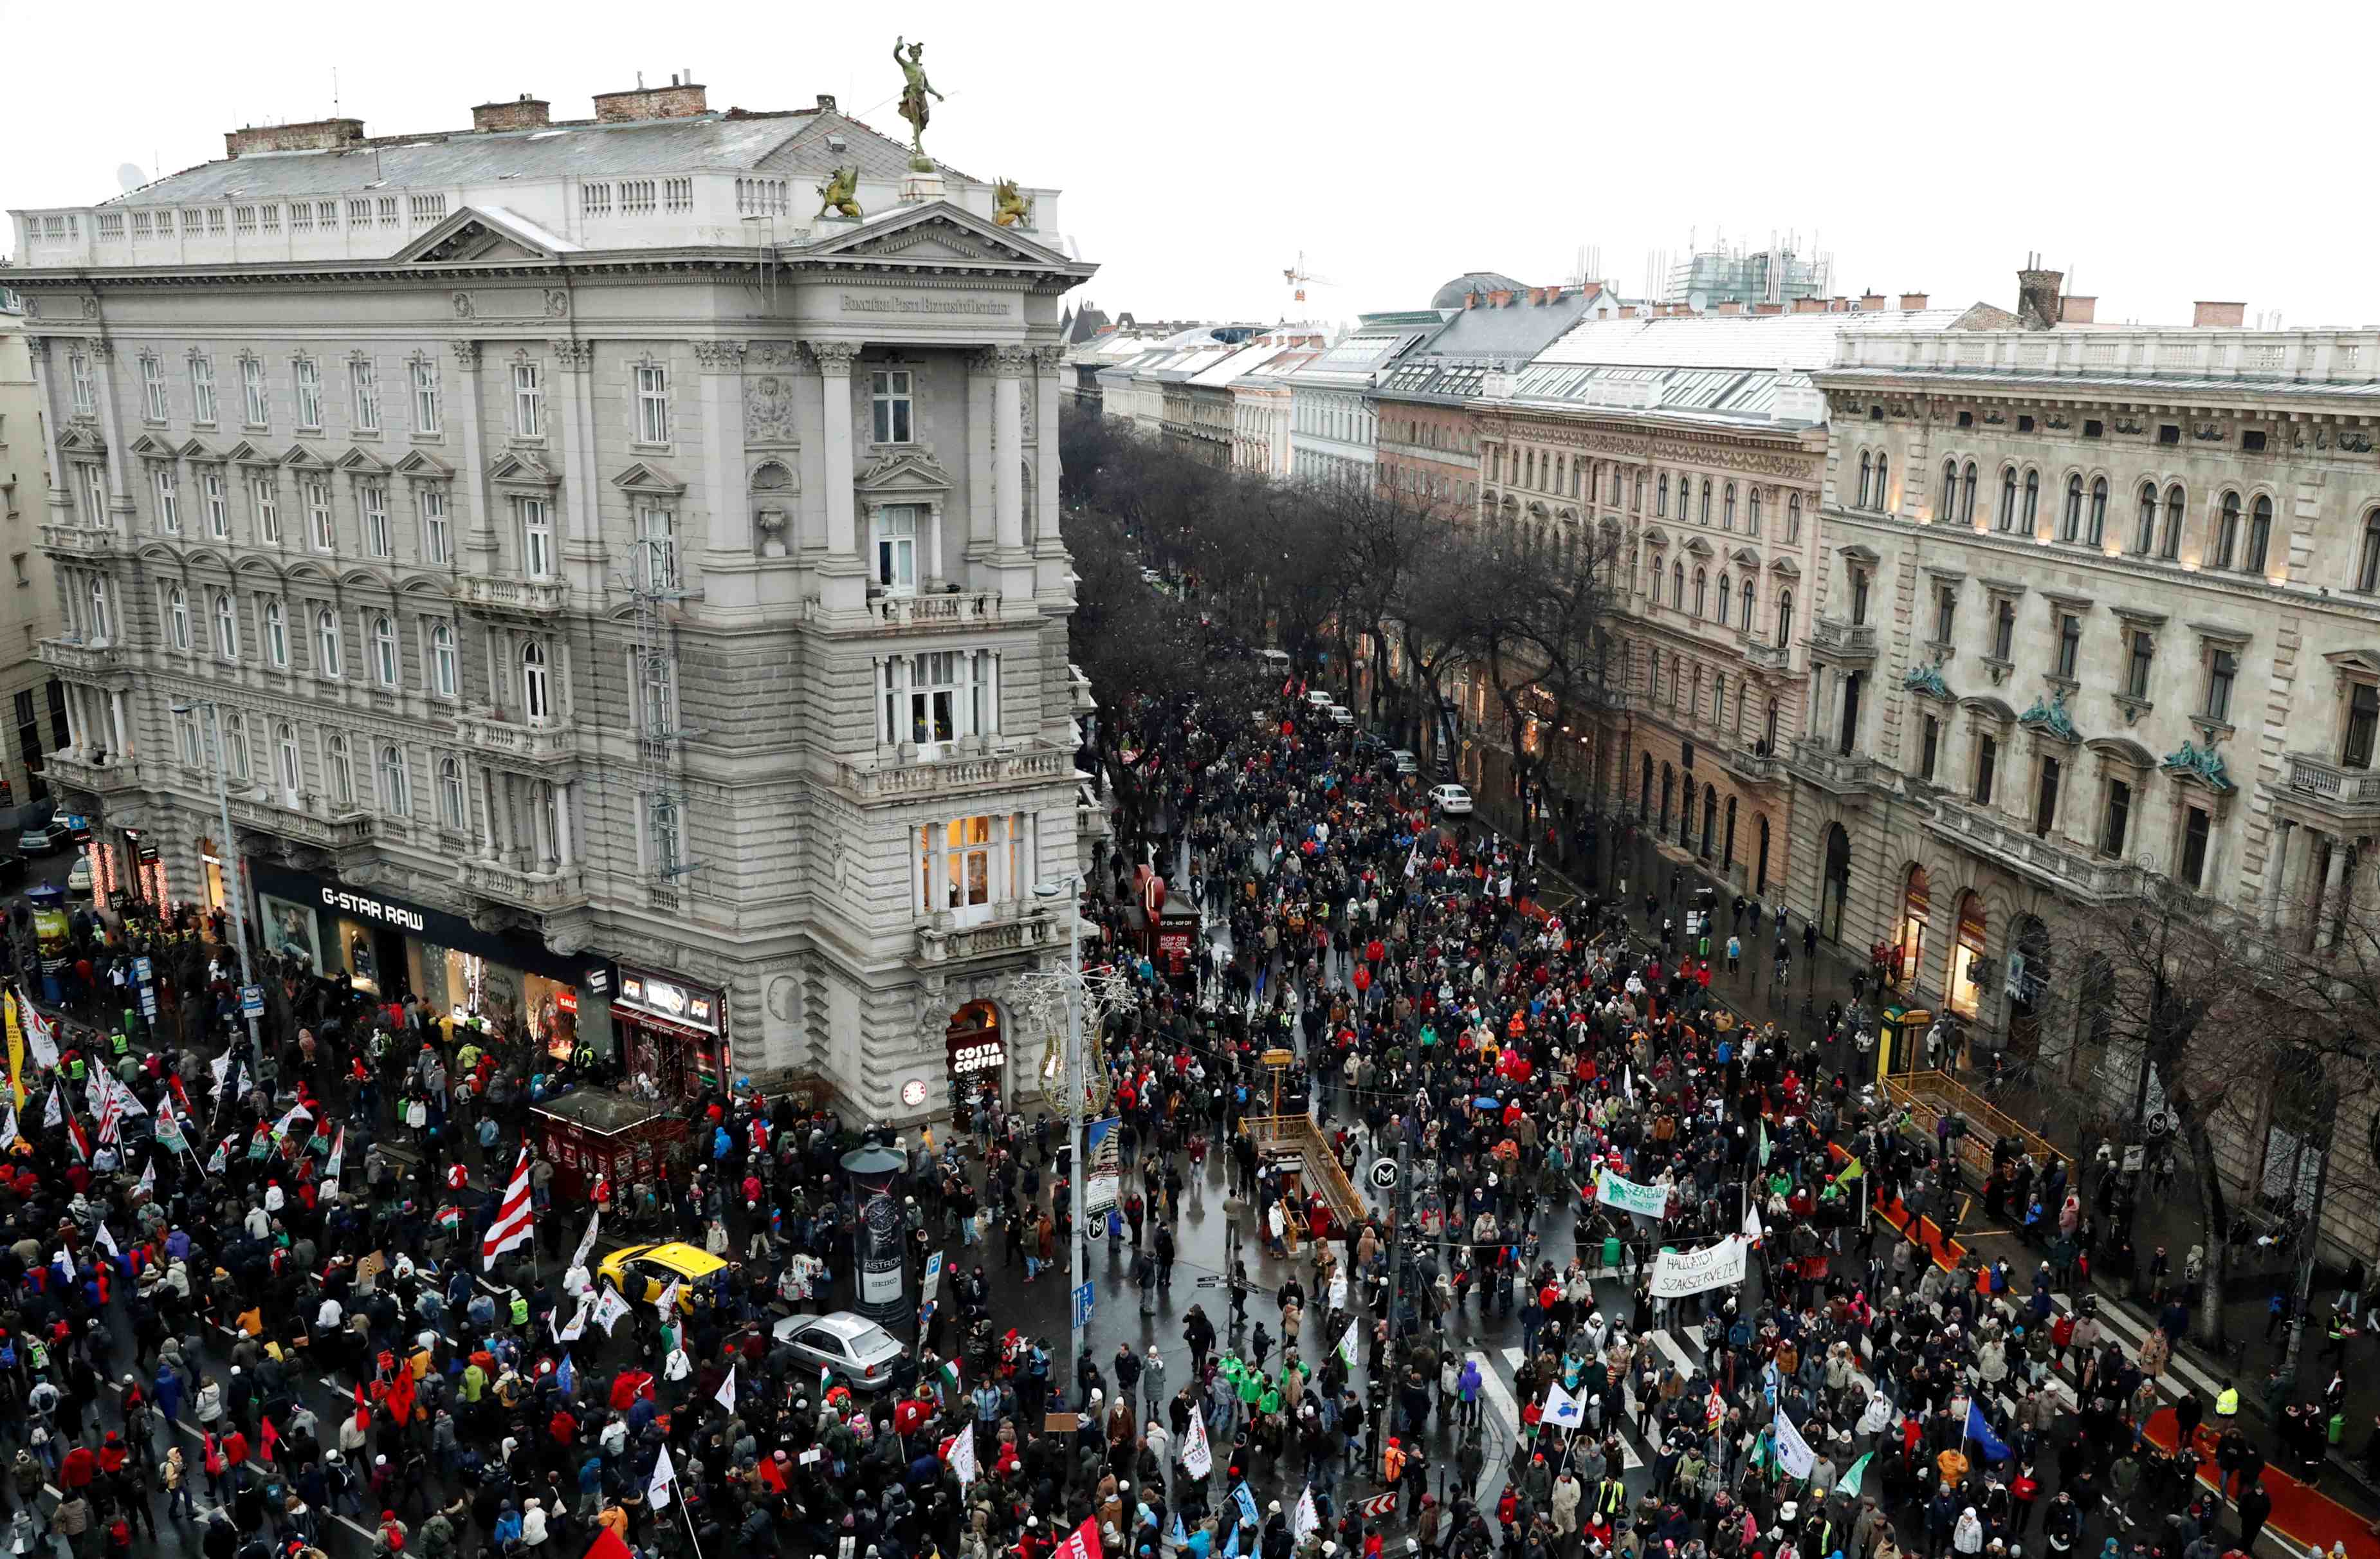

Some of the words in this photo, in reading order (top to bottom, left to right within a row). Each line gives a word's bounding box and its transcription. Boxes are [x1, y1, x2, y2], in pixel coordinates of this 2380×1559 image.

[892, 295, 920, 313] PESTI
[322, 887, 381, 919] G-STAR
[385, 905, 424, 931] RAW
[592, 984, 607, 994] RAW
[955, 1042, 1000, 1061] COSTA
[954, 1053, 1005, 1073] COFFEE
[864, 1256, 901, 1269] ASTRON
[929, 1257, 938, 1273] P
[871, 1277, 898, 1288] SEIKO
[1660, 1259, 1740, 1291] SZAKSZERVEZET
